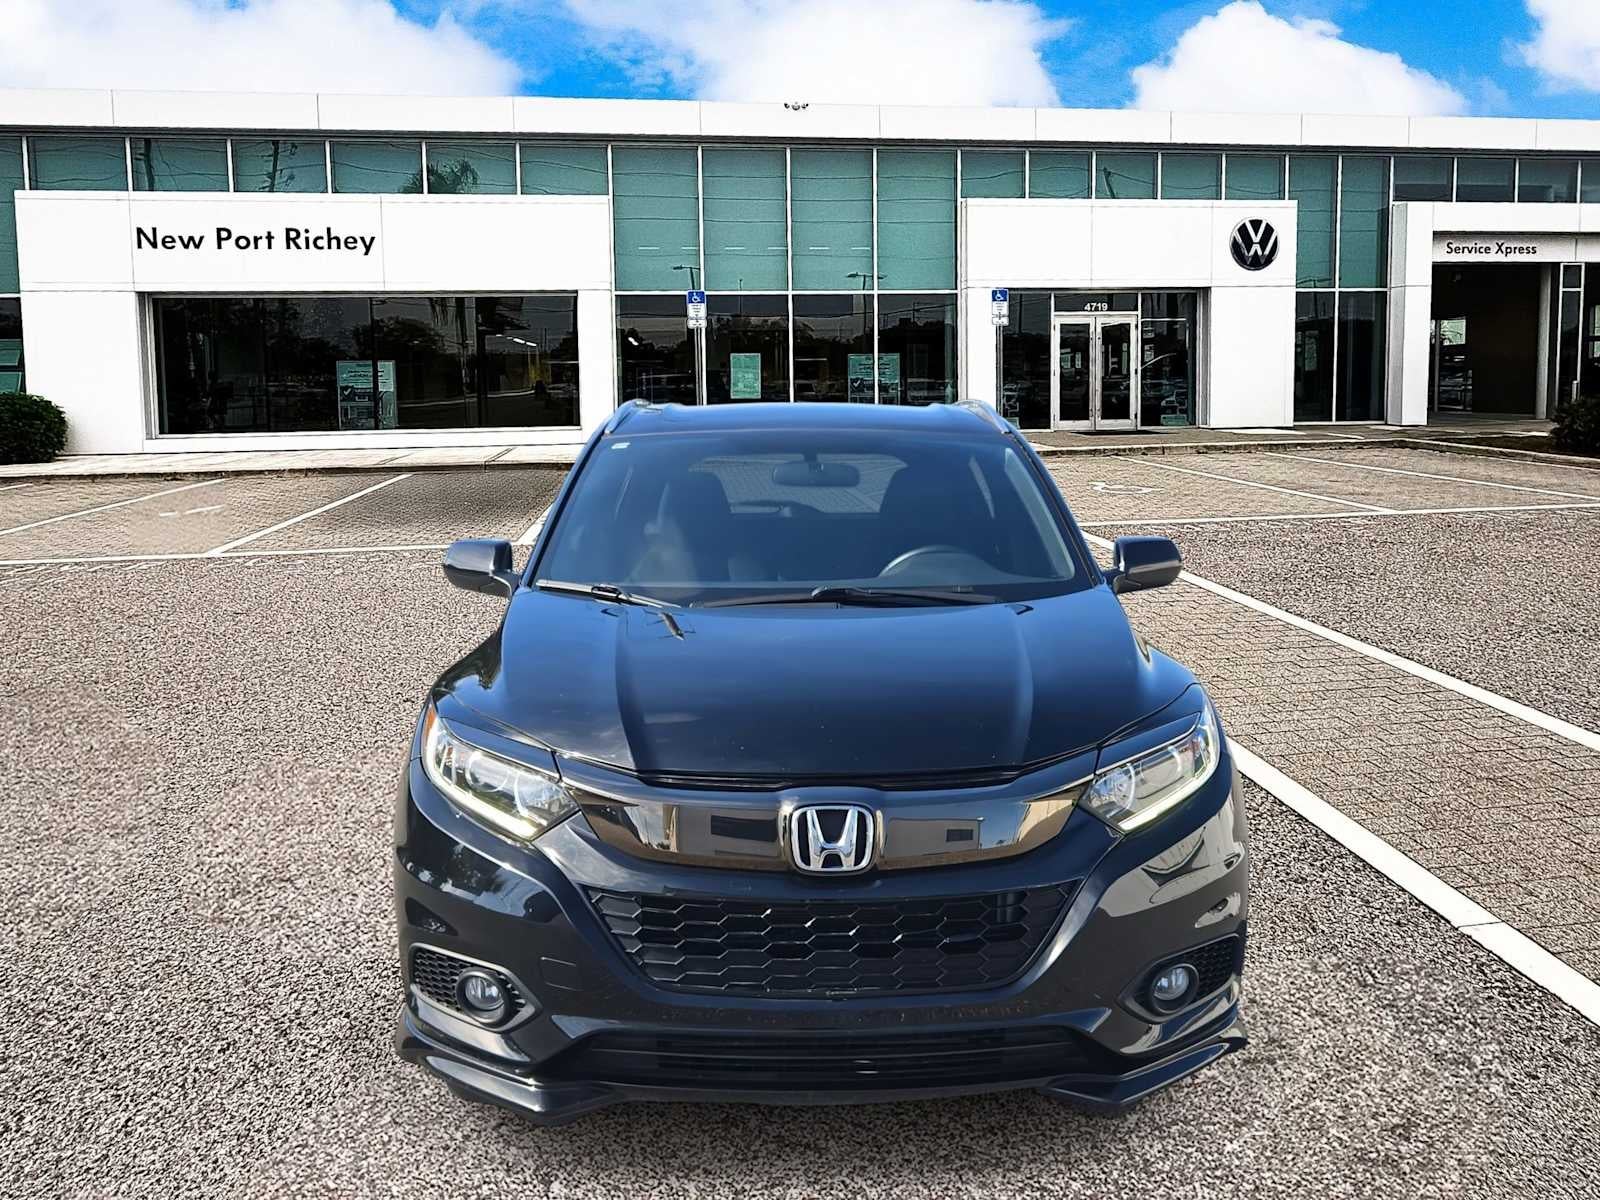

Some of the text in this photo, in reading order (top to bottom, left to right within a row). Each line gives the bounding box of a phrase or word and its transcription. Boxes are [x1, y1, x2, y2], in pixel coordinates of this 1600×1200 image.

[136, 226, 376, 256] New Port Richey
[1446, 241, 1538, 257] Service Xpress
[1084, 302, 1108, 311] 4719
